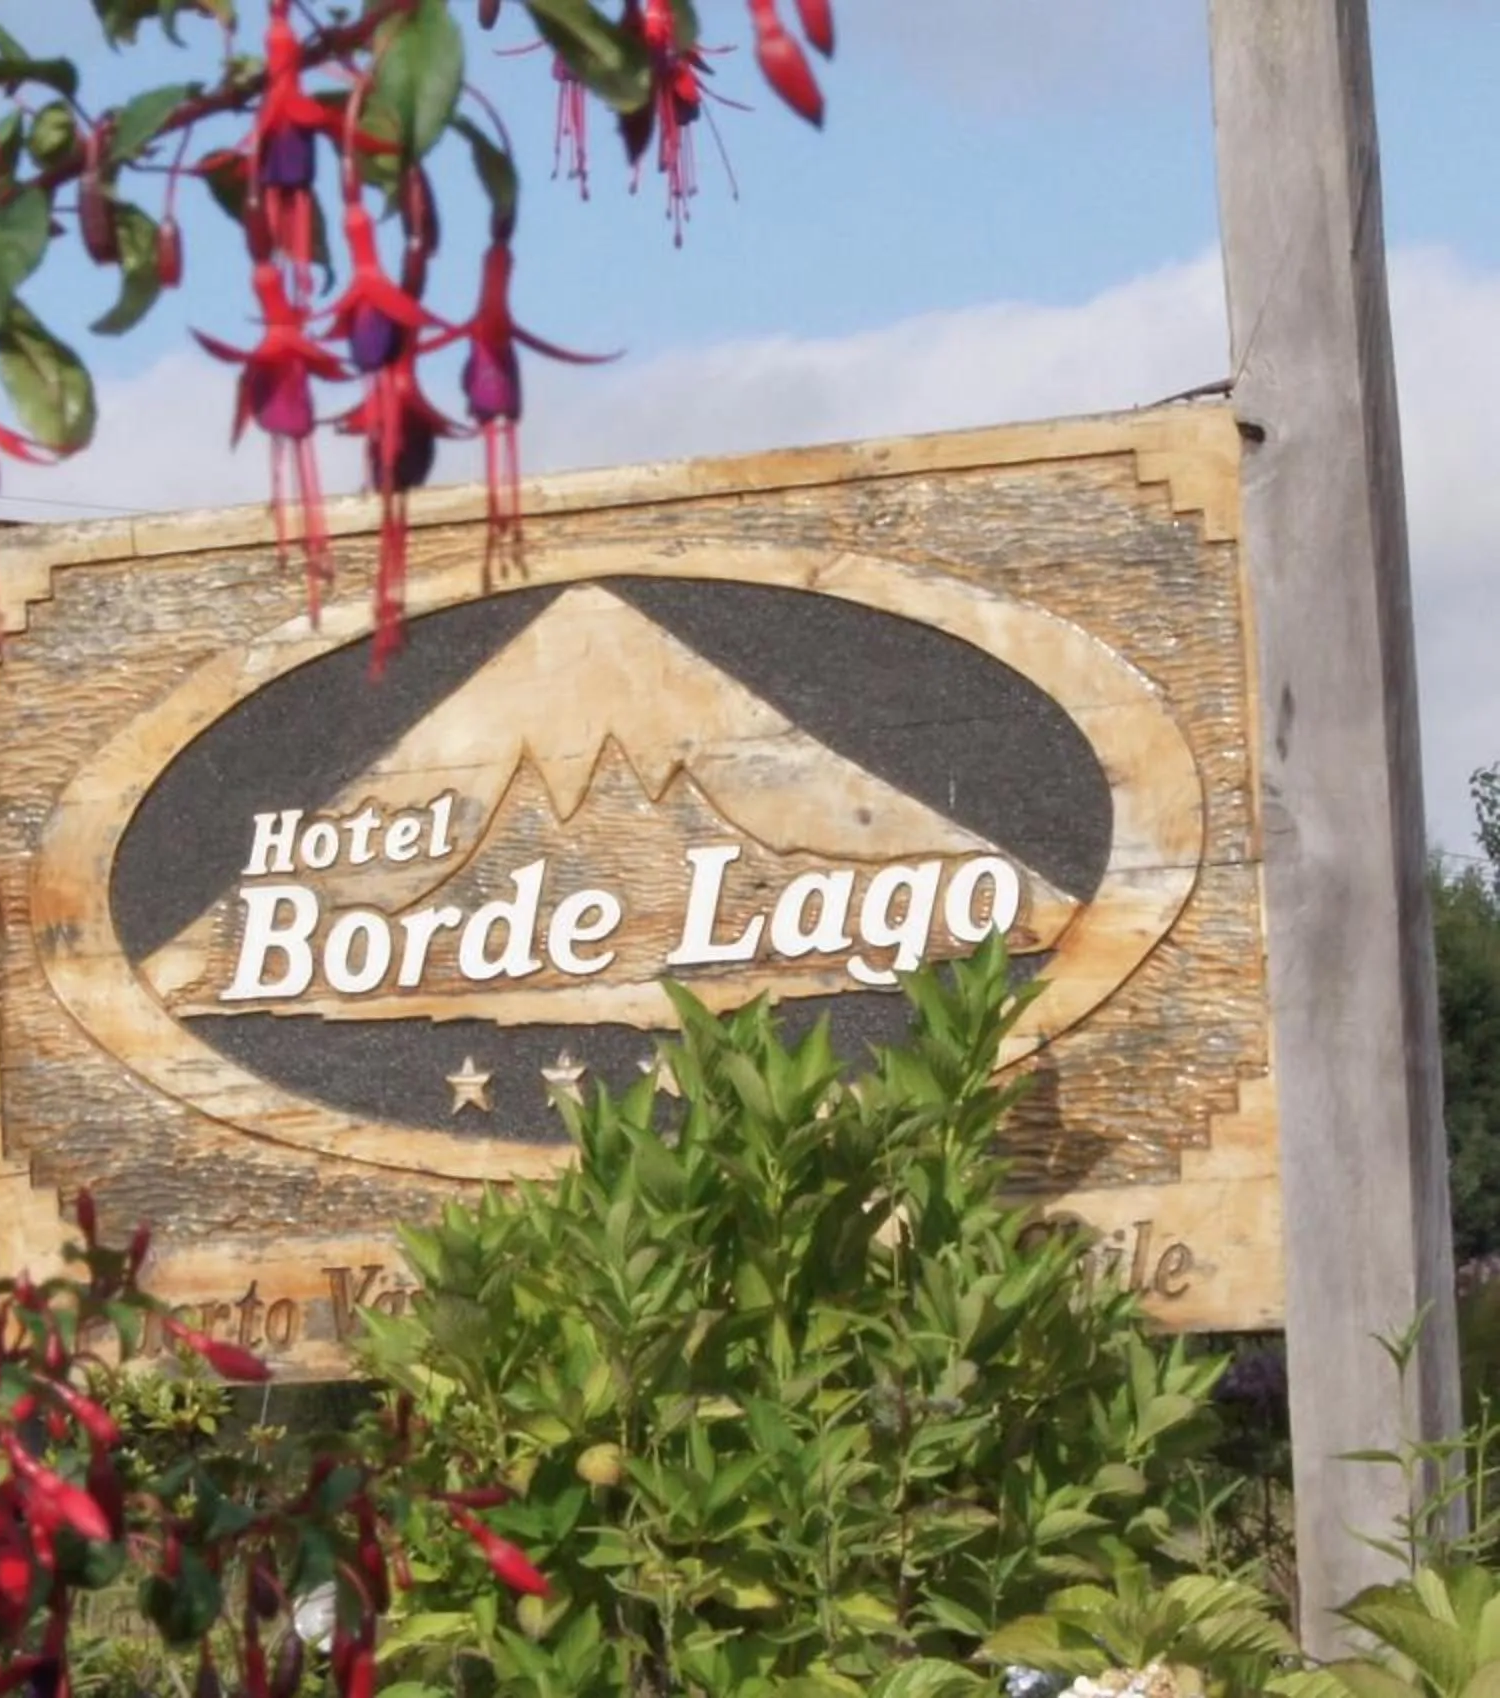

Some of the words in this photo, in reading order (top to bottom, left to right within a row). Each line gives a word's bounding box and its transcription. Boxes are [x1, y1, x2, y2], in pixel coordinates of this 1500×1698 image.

[241, 796, 453, 875] Hotel
[219, 858, 622, 1000] Borde
[666, 845, 1020, 985] Lago
